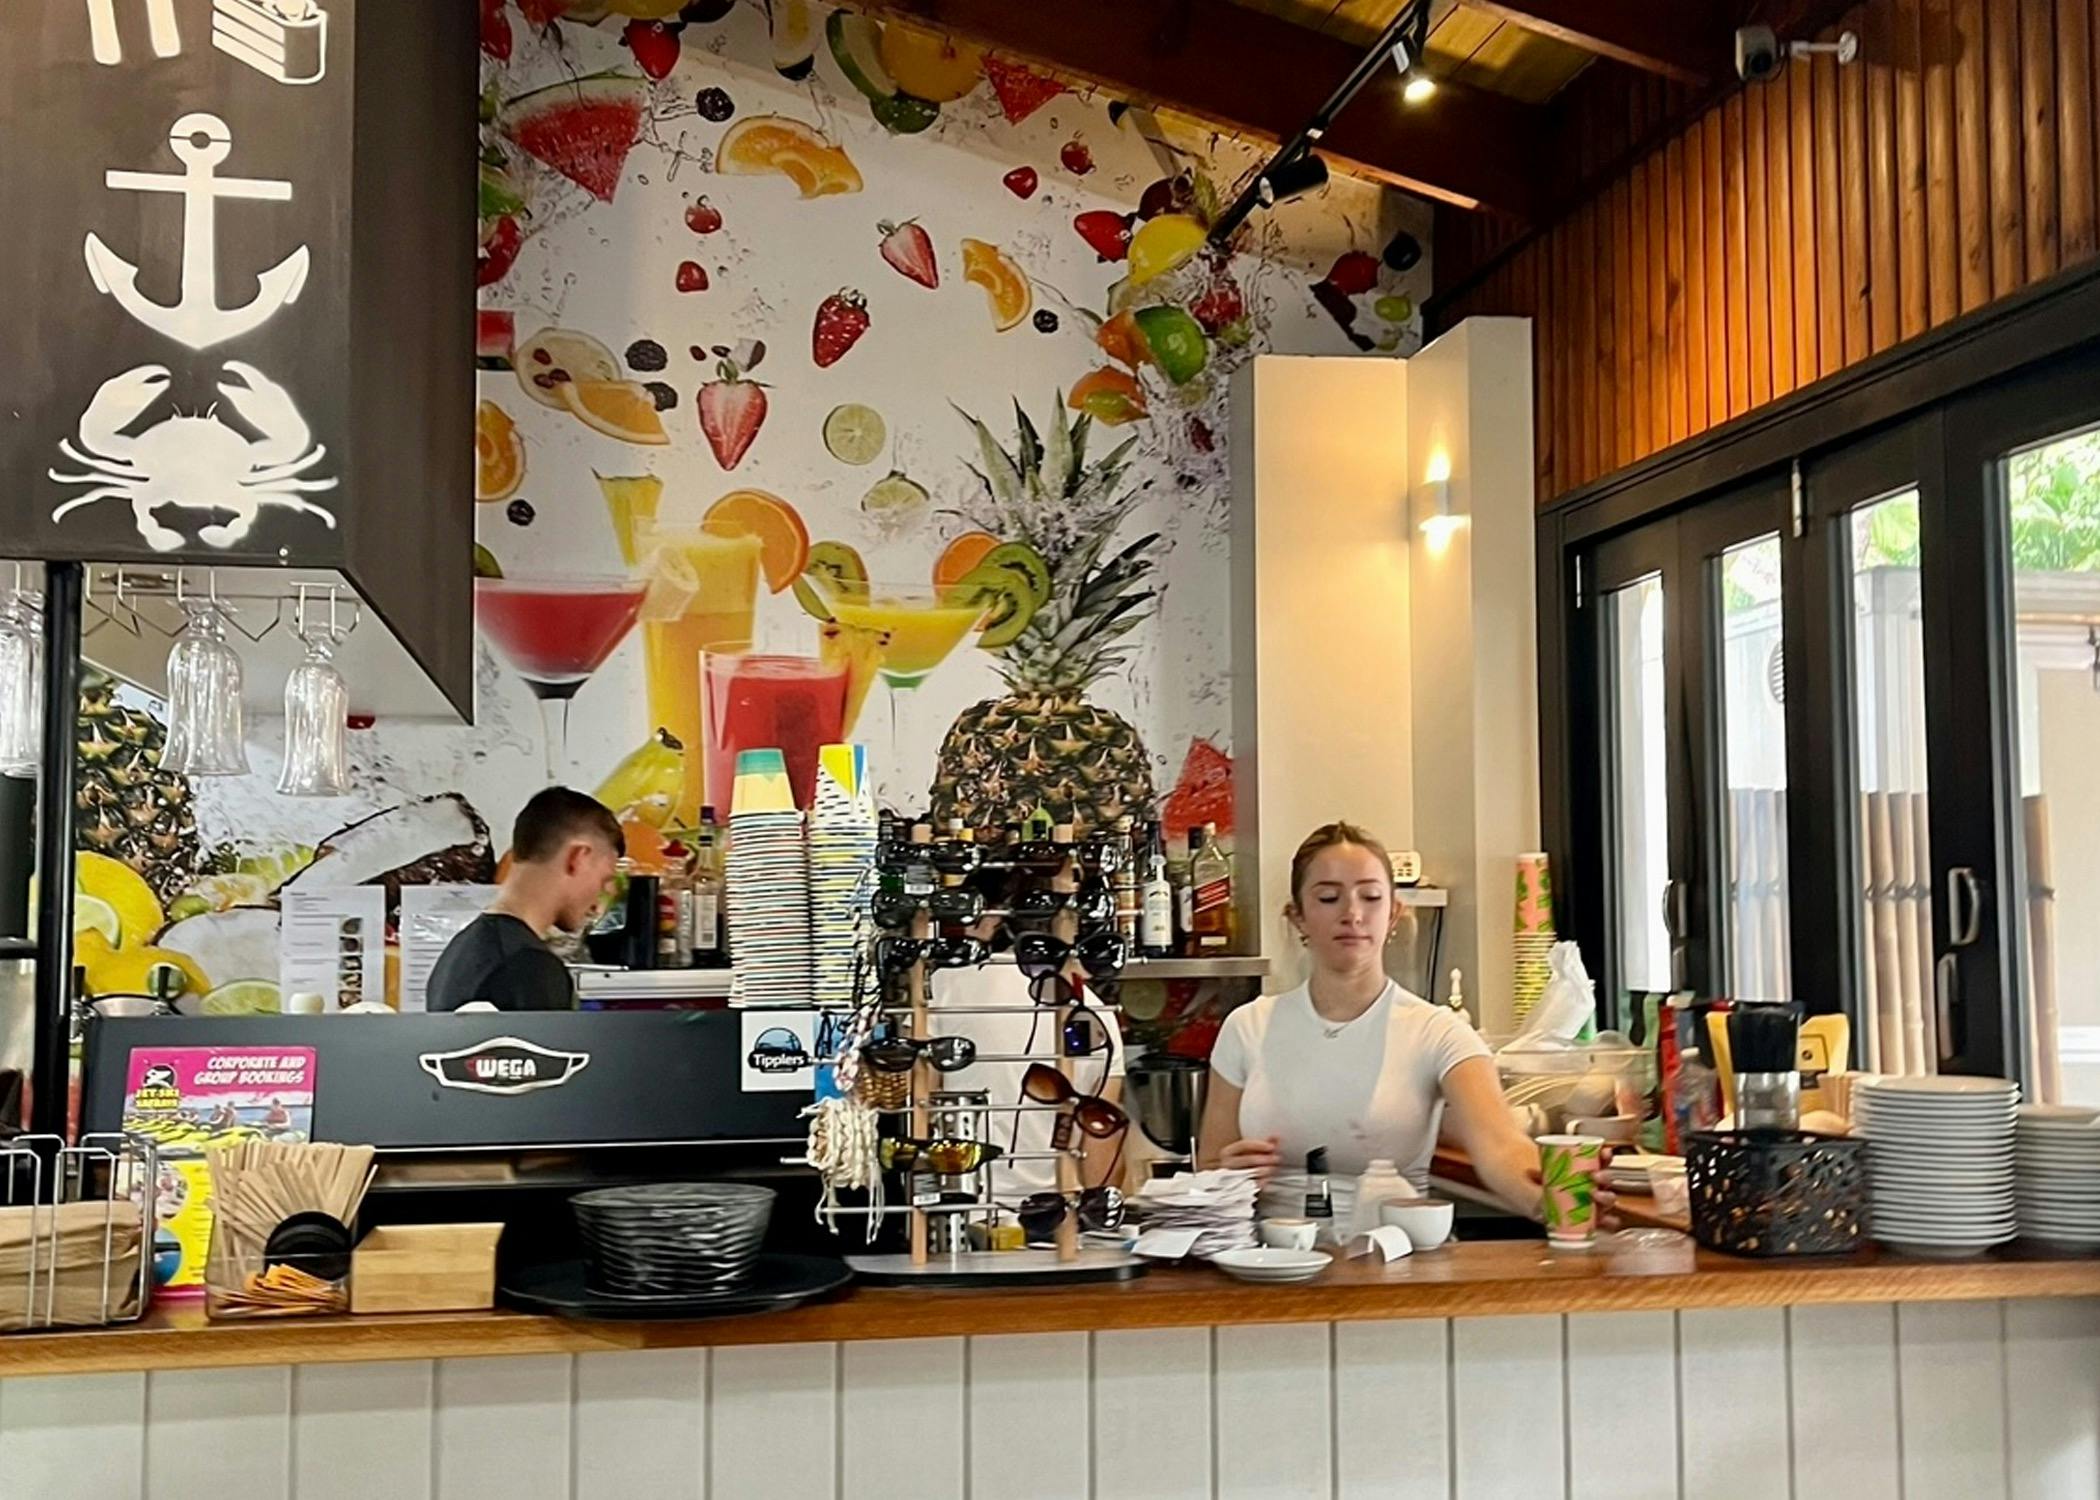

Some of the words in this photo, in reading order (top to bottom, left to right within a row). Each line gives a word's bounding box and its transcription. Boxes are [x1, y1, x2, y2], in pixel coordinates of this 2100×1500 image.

[208, 1056, 277, 1070] CORPORATE
[279, 1056, 306, 1069] AND
[753, 1053, 804, 1068] Tipplers
[476, 1059, 536, 1078] WEGA
[194, 1071, 237, 1085] GROUP
[238, 1070, 305, 1084] BOOKINGS
